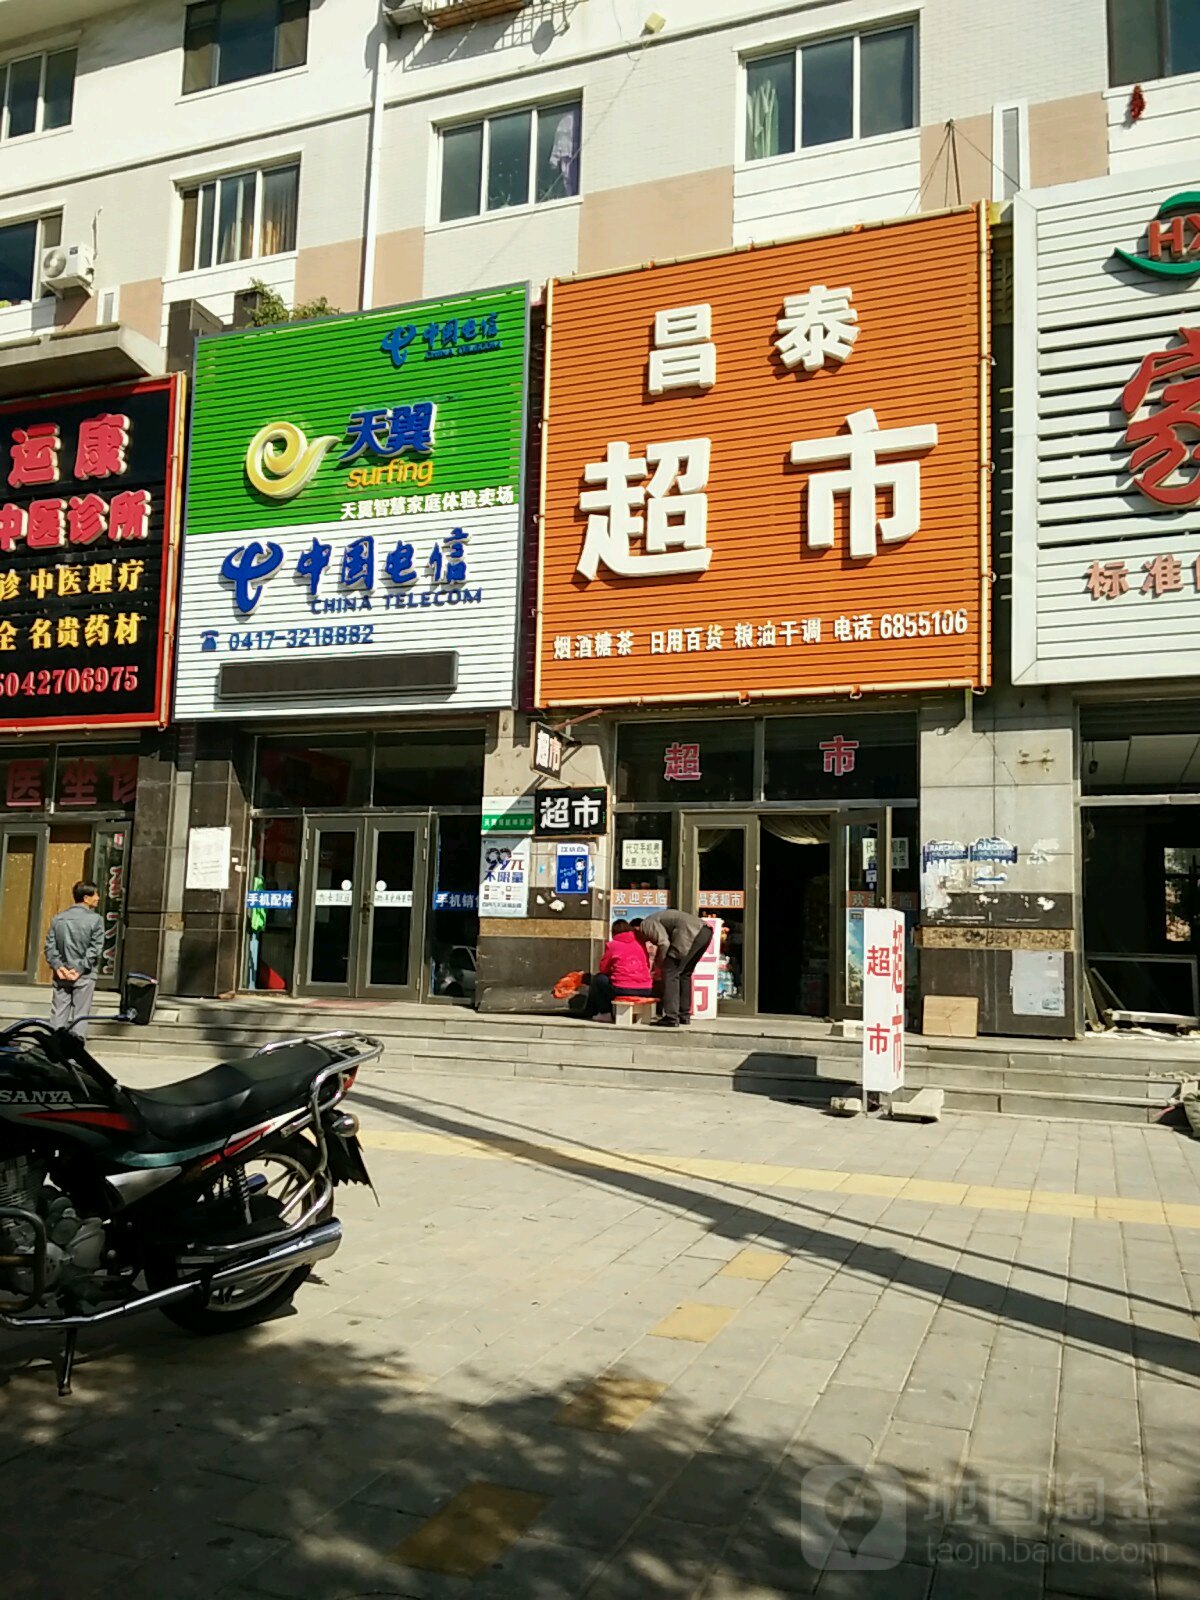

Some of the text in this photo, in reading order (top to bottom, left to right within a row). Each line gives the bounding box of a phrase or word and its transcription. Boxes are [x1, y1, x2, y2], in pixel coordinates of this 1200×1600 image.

[423, 312, 499, 350] 中国电信
[649, 285, 860, 395] 昌泰
[8, 413, 130, 488] 运康
[338, 401, 437, 461] 天翼
[346, 459, 433, 488] surfing
[340, 486, 515, 520] 天翼智慧家庭体验卖场
[576, 408, 938, 581] 超市
[0, 490, 151, 550] 中医诊所
[30, 559, 145, 599] 中医理疗
[297, 527, 472, 597] 中国电信
[1087, 554, 1200, 600] 标准
[311, 587, 482, 615] CHINA TELECOM
[29, 612, 142, 649] 名贵药材
[553, 608, 968, 659] 烟酒糖茶 日用百货 粮油干调 电话 6855106
[664, 735, 859, 781] 超市
[539, 795, 602, 829] 超市
[247, 891, 293, 908] 手机配件
[615, 892, 668, 905] 欢迎光临
[698, 892, 742, 906] 昌泰超市
[867, 945, 891, 1055] 超市
[0, 1090, 73, 1103] SANYA
